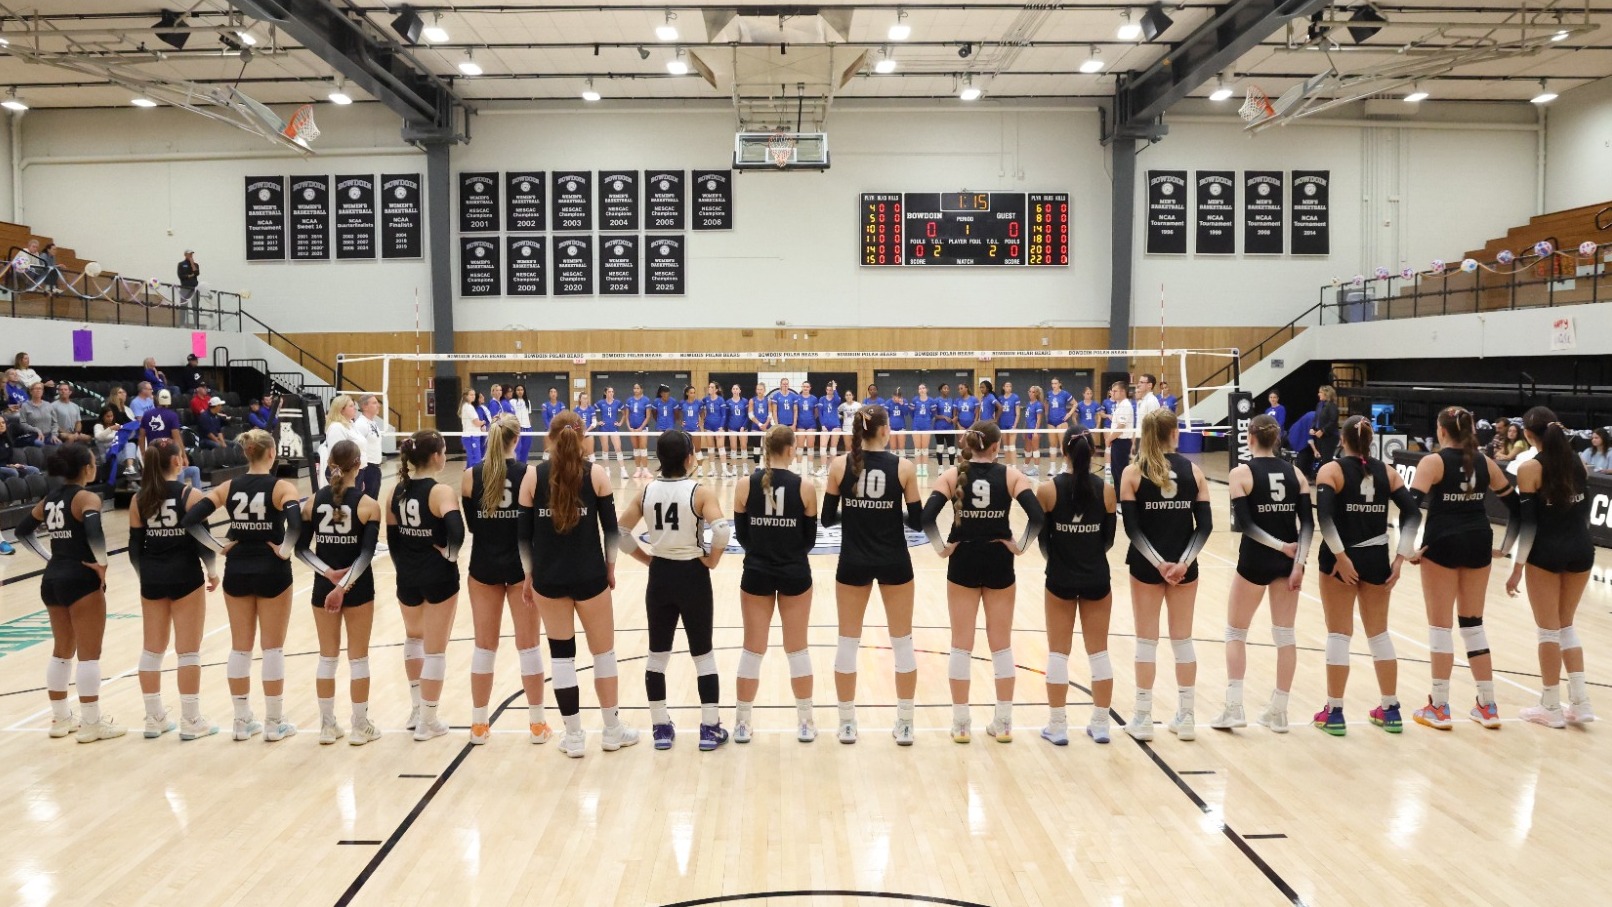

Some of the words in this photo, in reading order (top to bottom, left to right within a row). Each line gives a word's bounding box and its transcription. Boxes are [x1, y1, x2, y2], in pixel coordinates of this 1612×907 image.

[960, 194, 987, 209] 1:15
[879, 204, 885, 212] 0
[895, 204, 900, 212] 0
[1036, 204, 1042, 212] 6
[1046, 204, 1051, 212] 0
[1061, 204, 1066, 212] 0
[870, 214, 875, 222] 5
[879, 214, 885, 222] 0
[895, 214, 900, 222] 0
[1037, 214, 1042, 222] 8
[1046, 214, 1051, 222] 0
[1061, 214, 1066, 222] 0
[867, 225, 875, 233] 10
[879, 225, 885, 233] 0
[895, 225, 900, 233] 0
[927, 222, 936, 237] 0
[966, 225, 969, 234] 1
[1009, 222, 1018, 237] 0
[1046, 225, 1051, 233] 0
[1061, 225, 1066, 233] 0
[879, 235, 885, 243] 0
[895, 235, 900, 243] 0
[1034, 235, 1042, 243] 18
[1046, 235, 1051, 243] 0
[1061, 235, 1066, 243] 0
[879, 245, 885, 253] 0
[895, 245, 900, 253] 0
[916, 245, 923, 256] 0
[934, 245, 941, 256] 2
[990, 245, 996, 256] 2
[1011, 245, 1018, 256] 0
[1030, 245, 1042, 253] 20
[1046, 245, 1051, 253] 0
[1061, 245, 1066, 253] 0
[867, 255, 875, 263] 15
[879, 255, 885, 263] 0
[895, 255, 900, 263] 0
[1030, 255, 1042, 263] 22
[1046, 255, 1051, 263] 0
[1061, 255, 1066, 263] 0
[855, 469, 887, 499] 10
[1268, 472, 1287, 502] 5
[1360, 475, 1376, 503] 4
[971, 479, 990, 508] 9
[763, 486, 785, 516] 11
[845, 498, 894, 509] BOWDOIN
[1145, 500, 1192, 510] BOWDOIN
[232, 492, 266, 521] 24
[45, 499, 65, 530] 26
[398, 498, 424, 527] 19
[654, 502, 680, 531] 14
[959, 509, 1005, 519] BOWDOIN
[231, 522, 273, 531] BOWDOIN
[750, 516, 797, 527] BOWDOIN
[399, 527, 433, 537] OWDOIN
[1055, 522, 1101, 533] BOWDOIN
[316, 535, 358, 544] BOWDOIN
